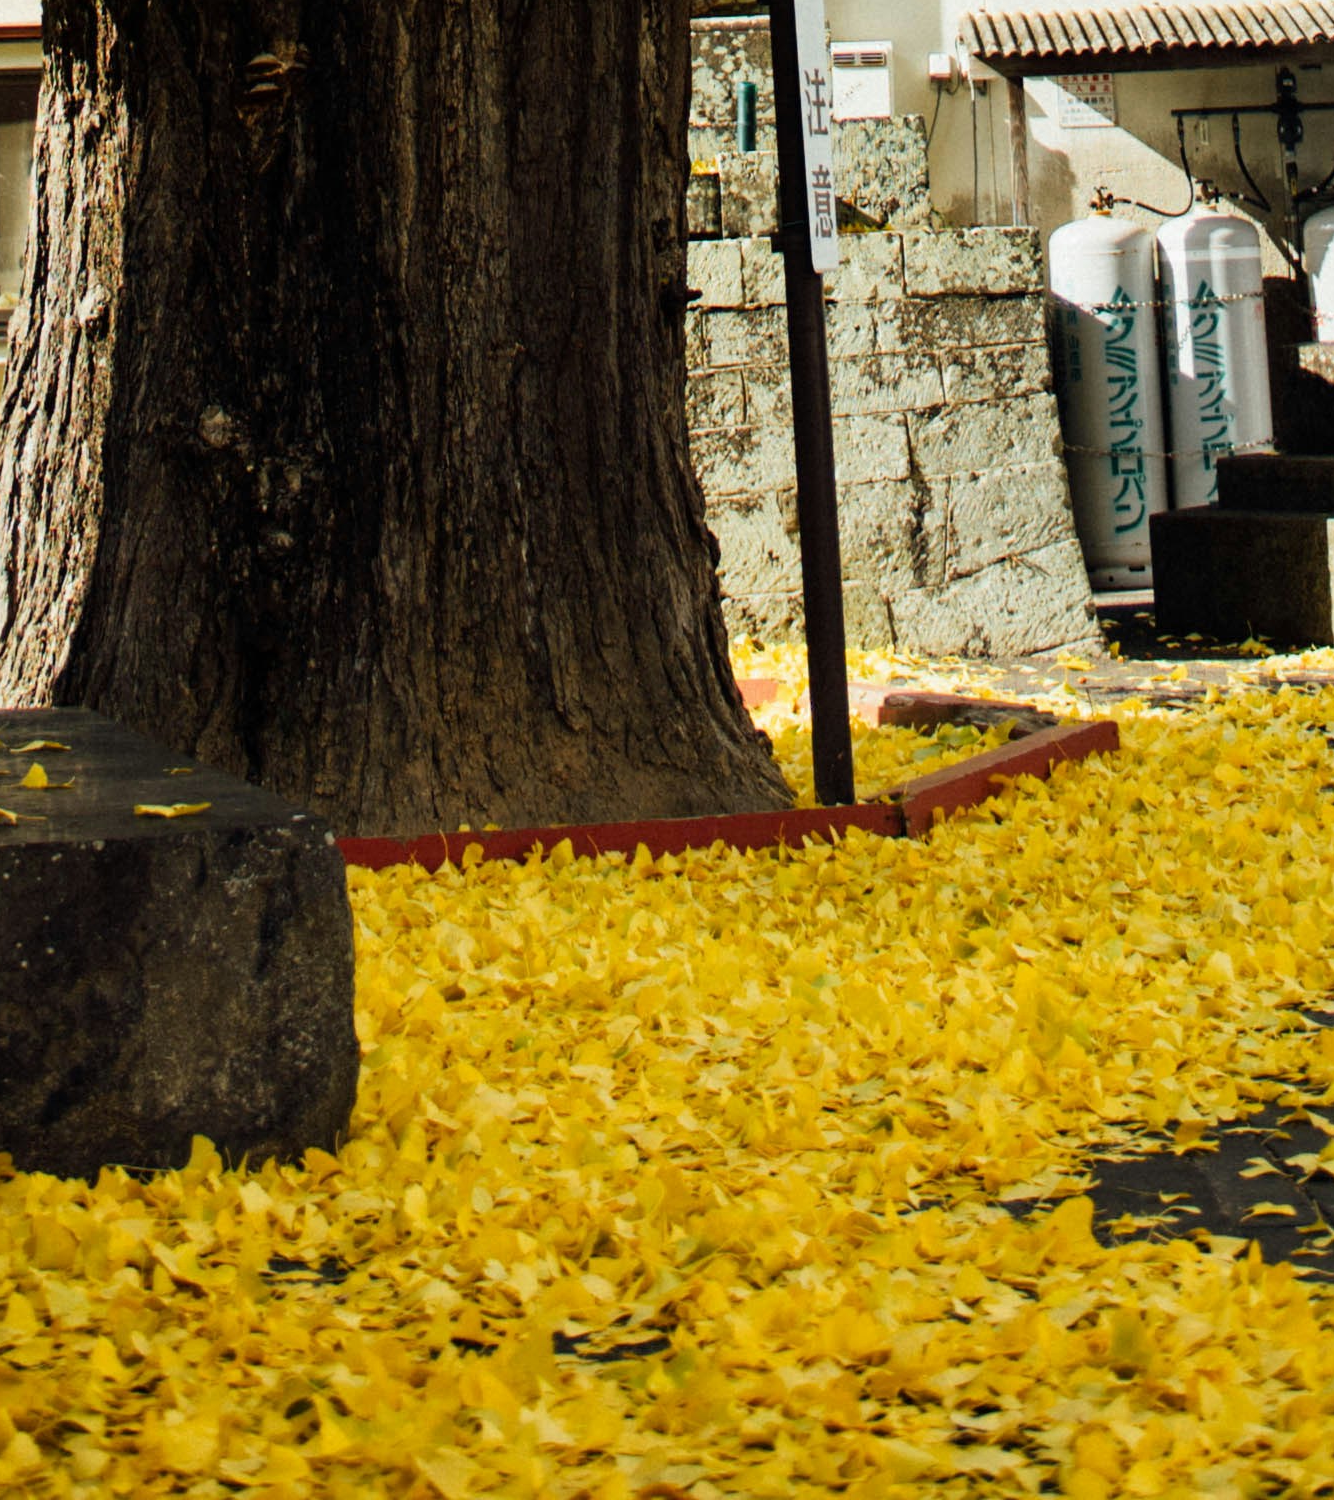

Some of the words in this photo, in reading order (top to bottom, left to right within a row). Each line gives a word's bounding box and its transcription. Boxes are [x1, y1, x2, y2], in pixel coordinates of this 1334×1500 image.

[804, 67, 833, 238] 注意
[1104, 315, 1146, 534] クミアイプロパン
